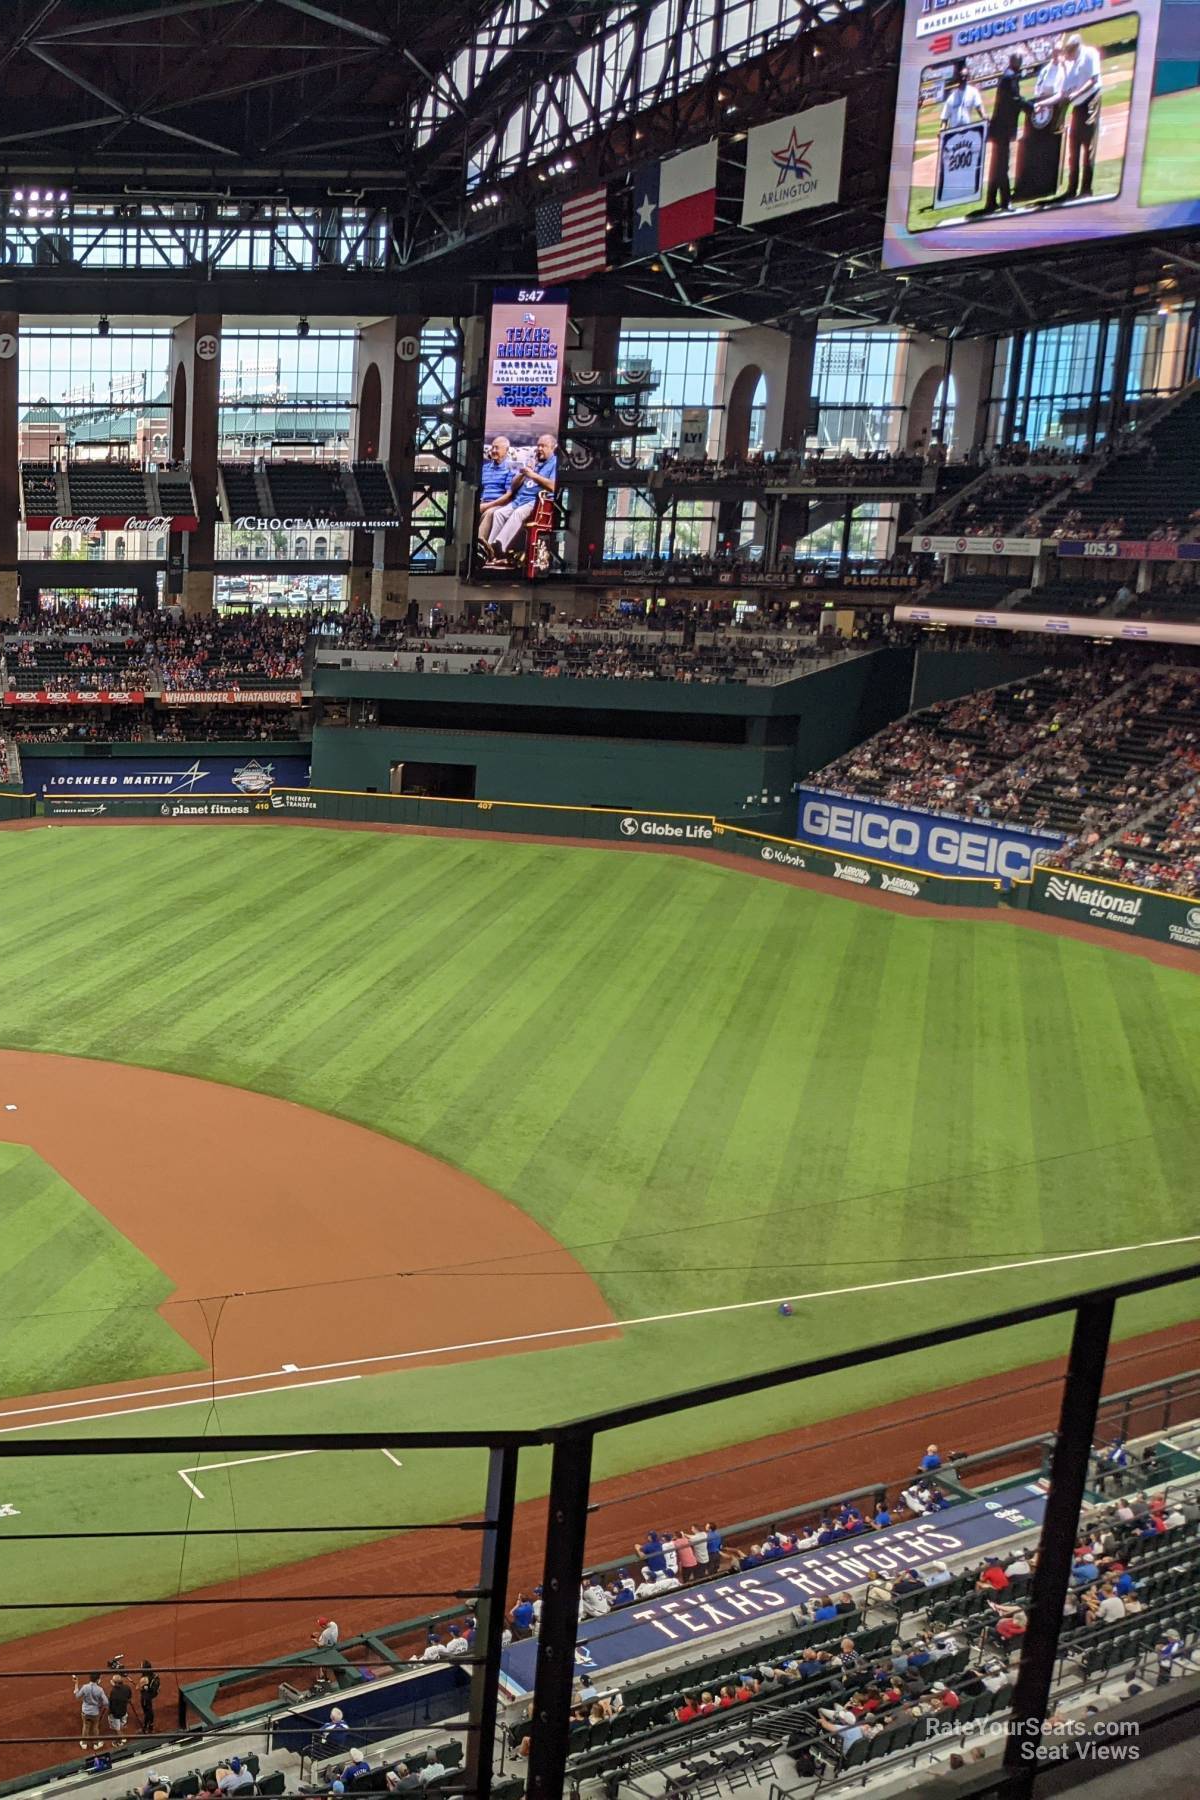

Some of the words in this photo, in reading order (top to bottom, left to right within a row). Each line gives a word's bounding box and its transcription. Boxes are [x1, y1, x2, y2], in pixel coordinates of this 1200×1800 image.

[924, 11, 970, 30] BASEBALL
[975, 3, 999, 16] HALL
[958, 16, 1018, 46] CHUCK
[1023, 0, 1104, 29] MORGAN
[760, 180, 817, 206] ARLINGTON
[518, 290, 544, 301] 5:47
[506, 327, 550, 343] TEXAS
[1, 339, 10, 353] 7
[199, 341, 216, 355] 29
[401, 342, 414, 356] 10
[496, 343, 557, 358] RANGERS
[502, 386, 547, 396] CHUCK
[496, 396, 551, 407] MORGAN
[243, 516, 330, 530] CHOCTAW
[1083, 542, 1117, 556] 105.3
[844, 576, 917, 586] PLUCKERS
[165, 692, 228, 703] WHATABURGER
[233, 692, 298, 702] WHATABURGER
[50, 776, 117, 785] LOCKHEED
[123, 775, 173, 784] MARTIN
[172, 804, 208, 816] planet
[211, 803, 249, 814] fitness
[286, 801, 317, 809] TRANSFER
[641, 821, 684, 837] Globe
[686, 823, 712, 839] Life
[803, 801, 920, 856] GEICO
[774, 850, 806, 868] Kubota
[843, 865, 866, 879] ARROW
[891, 877, 914, 891] ARROW
[1066, 883, 1141, 916] National
[1089, 908, 1103, 918] Car
[1106, 912, 1136, 925] Rental
[633, 1578, 787, 1639] TEXAS
[777, 1523, 963, 1595] RANGERS
